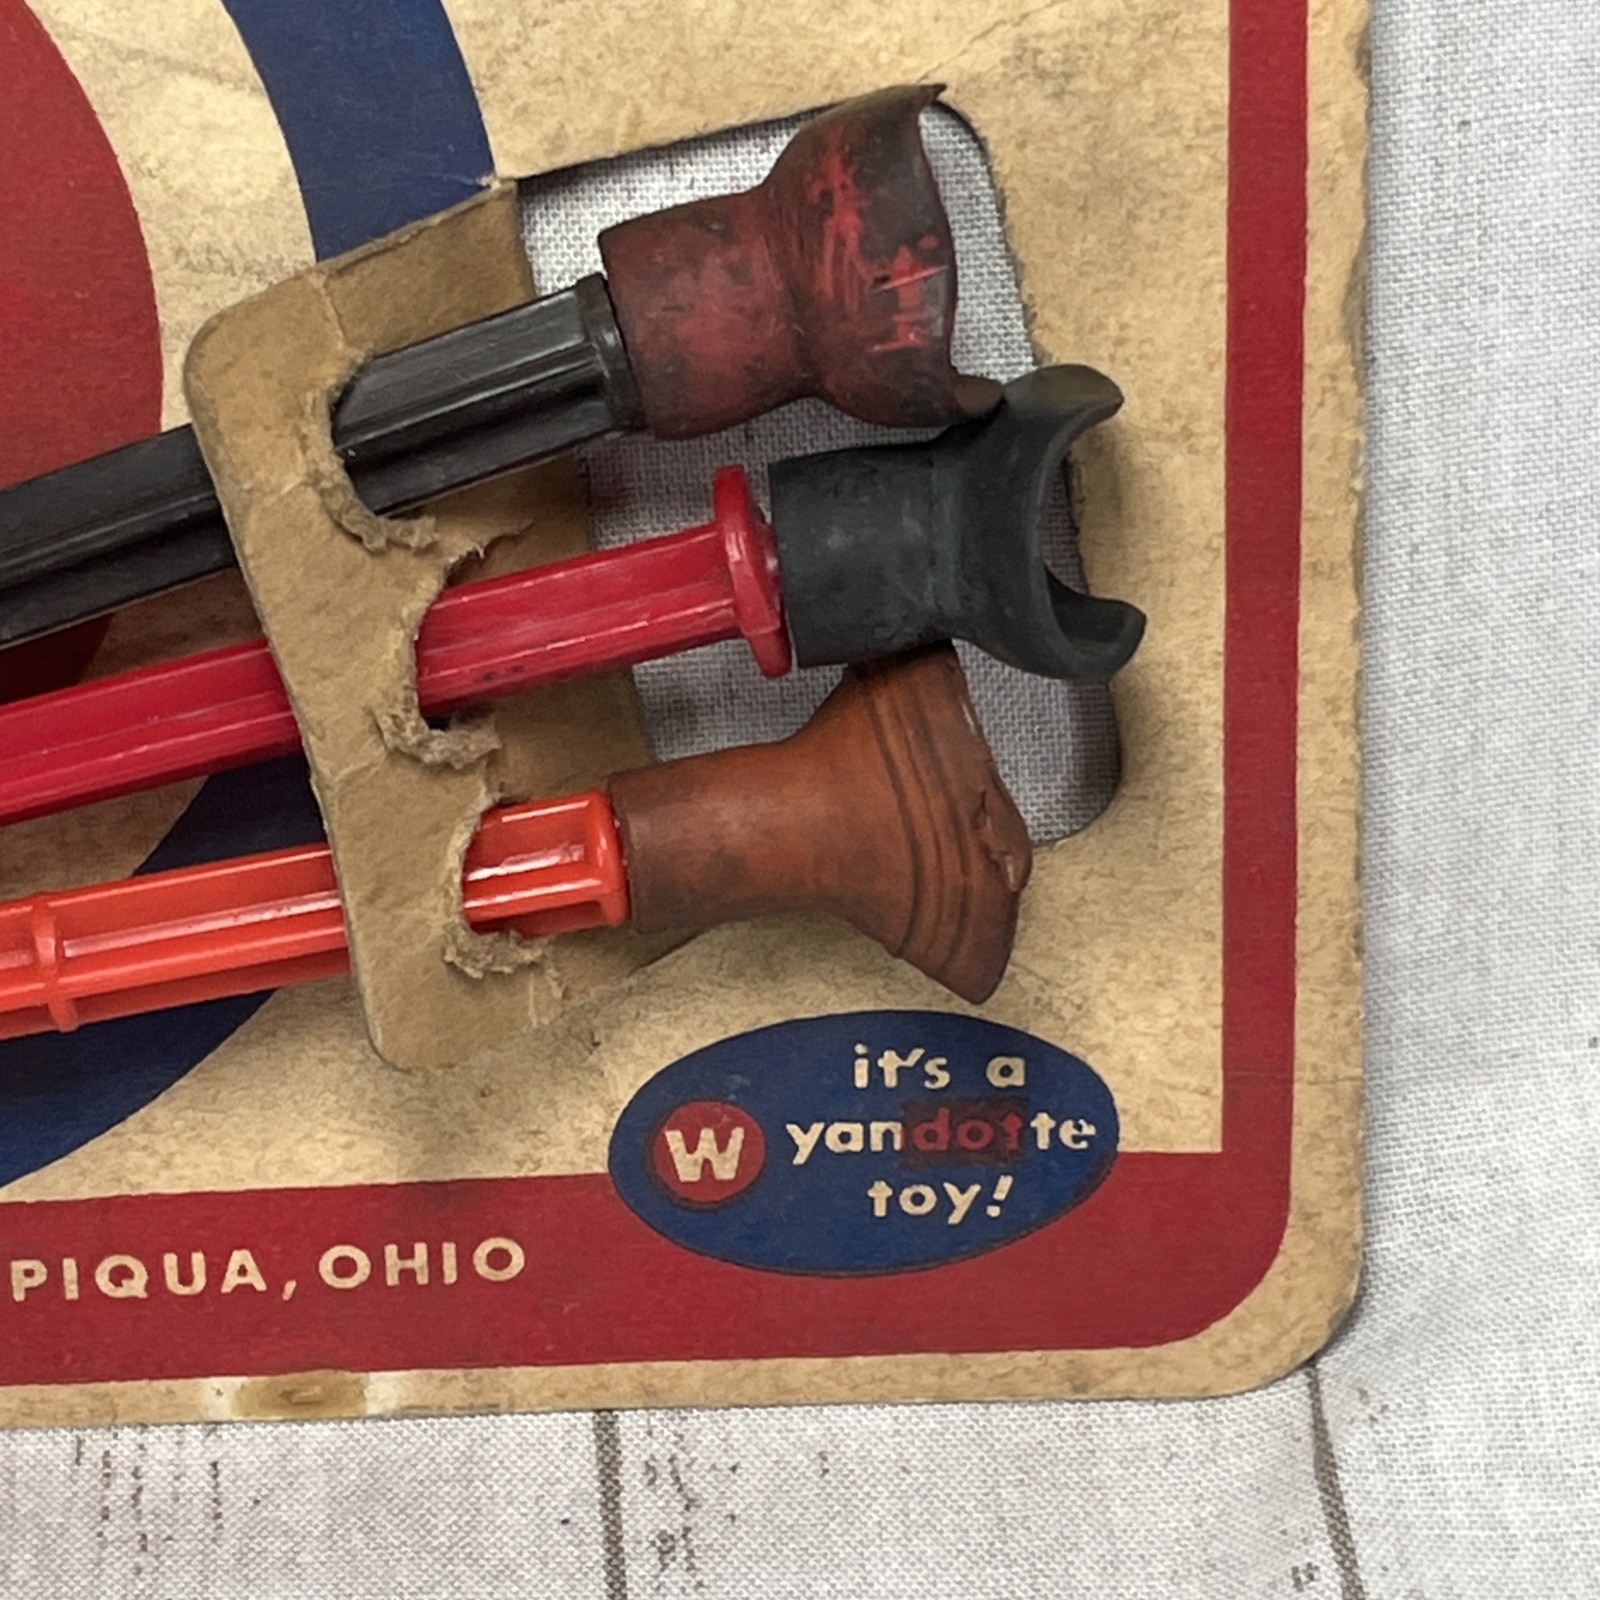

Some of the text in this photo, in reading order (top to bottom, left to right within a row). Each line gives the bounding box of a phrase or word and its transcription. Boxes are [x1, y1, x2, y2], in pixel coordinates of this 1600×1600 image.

[853, 1043, 1027, 1089] it's a
[665, 1126, 745, 1183] W
[786, 1107, 1097, 1166] yandotte
[867, 1174, 1014, 1225] toy!
[9, 1236, 526, 1302] PIQUA, OHIO
